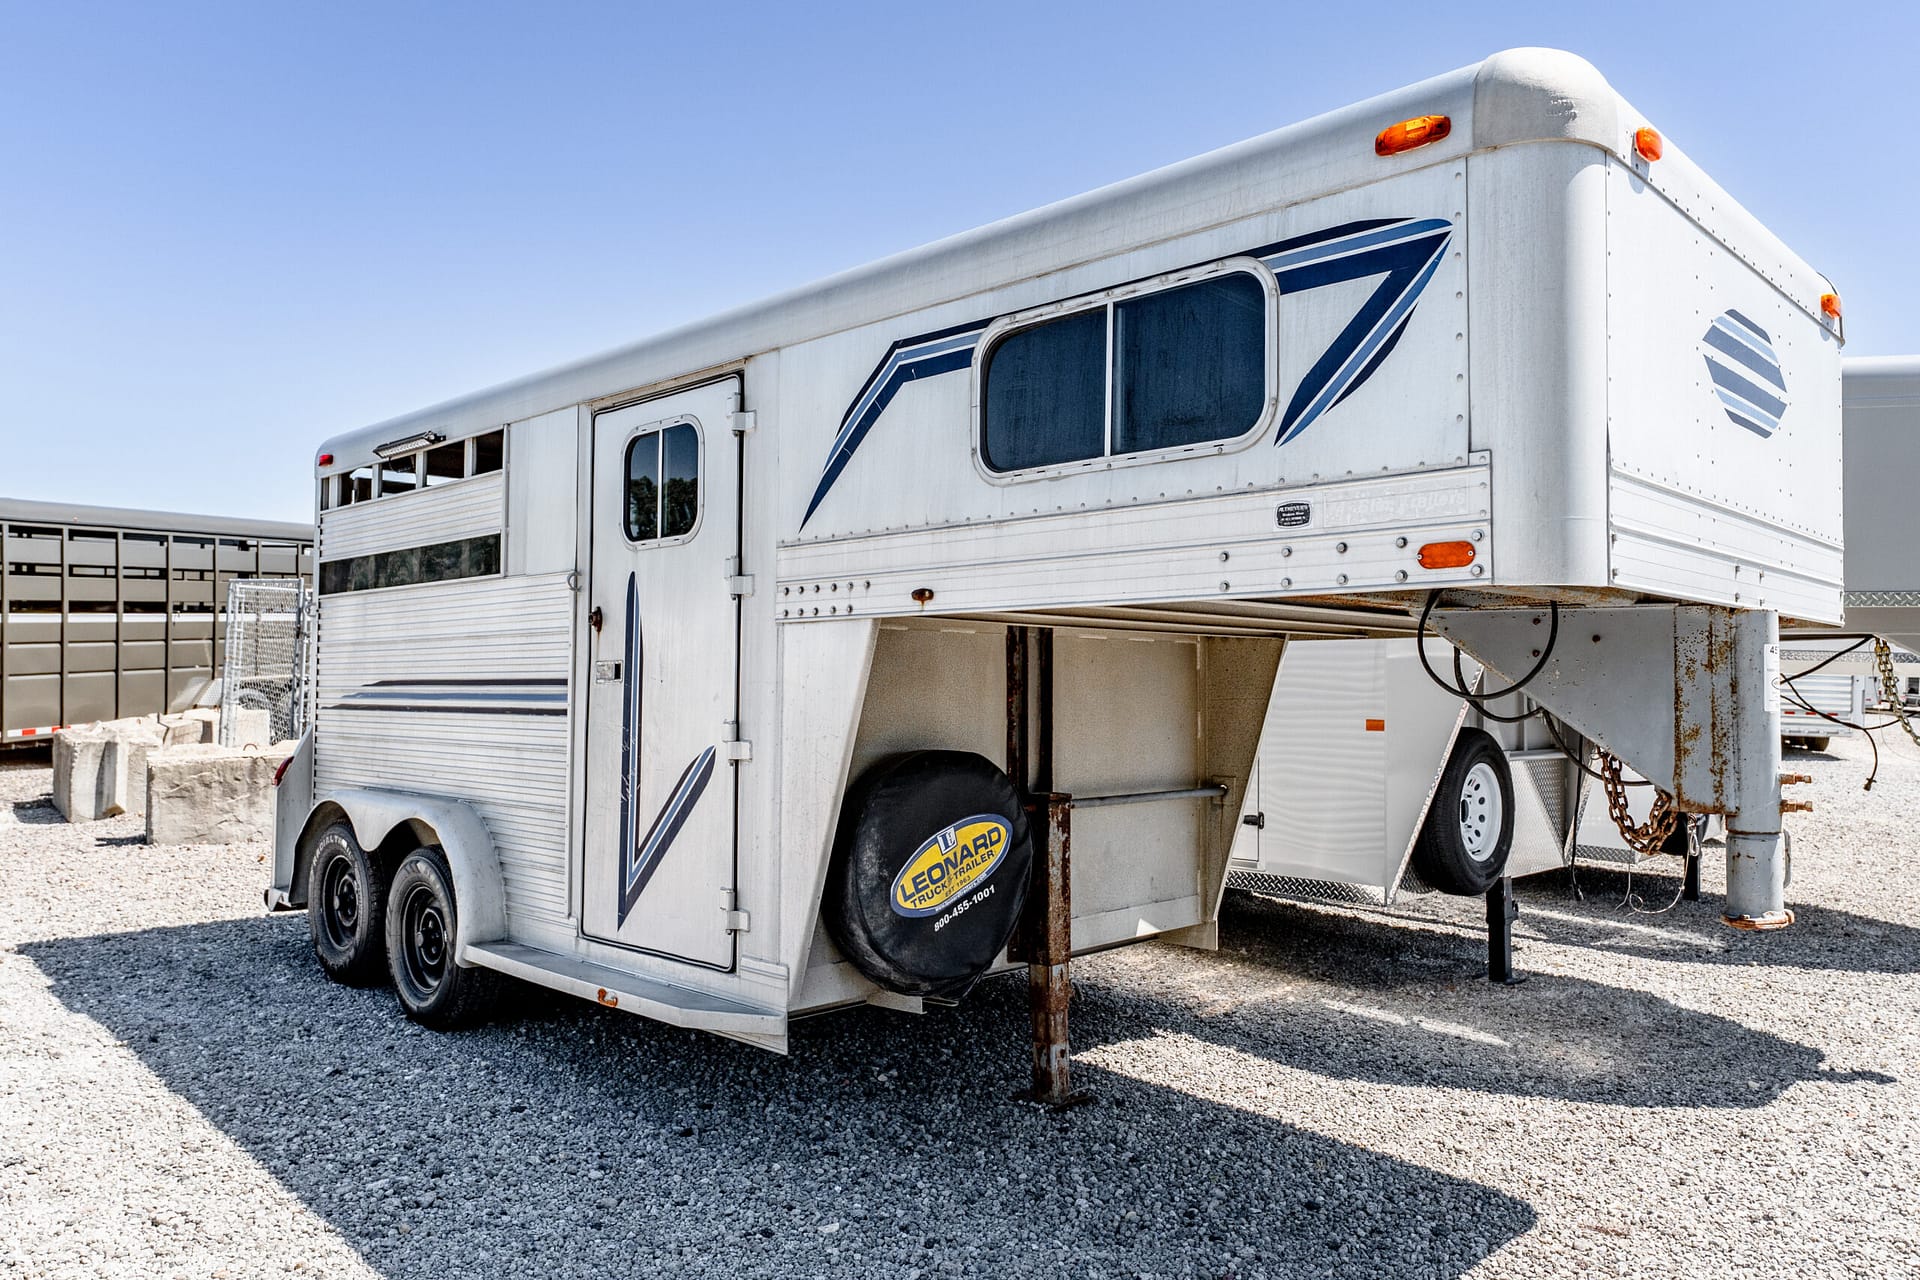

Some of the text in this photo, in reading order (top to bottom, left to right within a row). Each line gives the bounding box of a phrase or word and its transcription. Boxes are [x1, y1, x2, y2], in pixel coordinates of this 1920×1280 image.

[900, 826, 1002, 903] LEONARD
[910, 879, 948, 908] TRUCK
[953, 849, 995, 880] TRAILER
[934, 884, 996, 932] 800-455-1001
